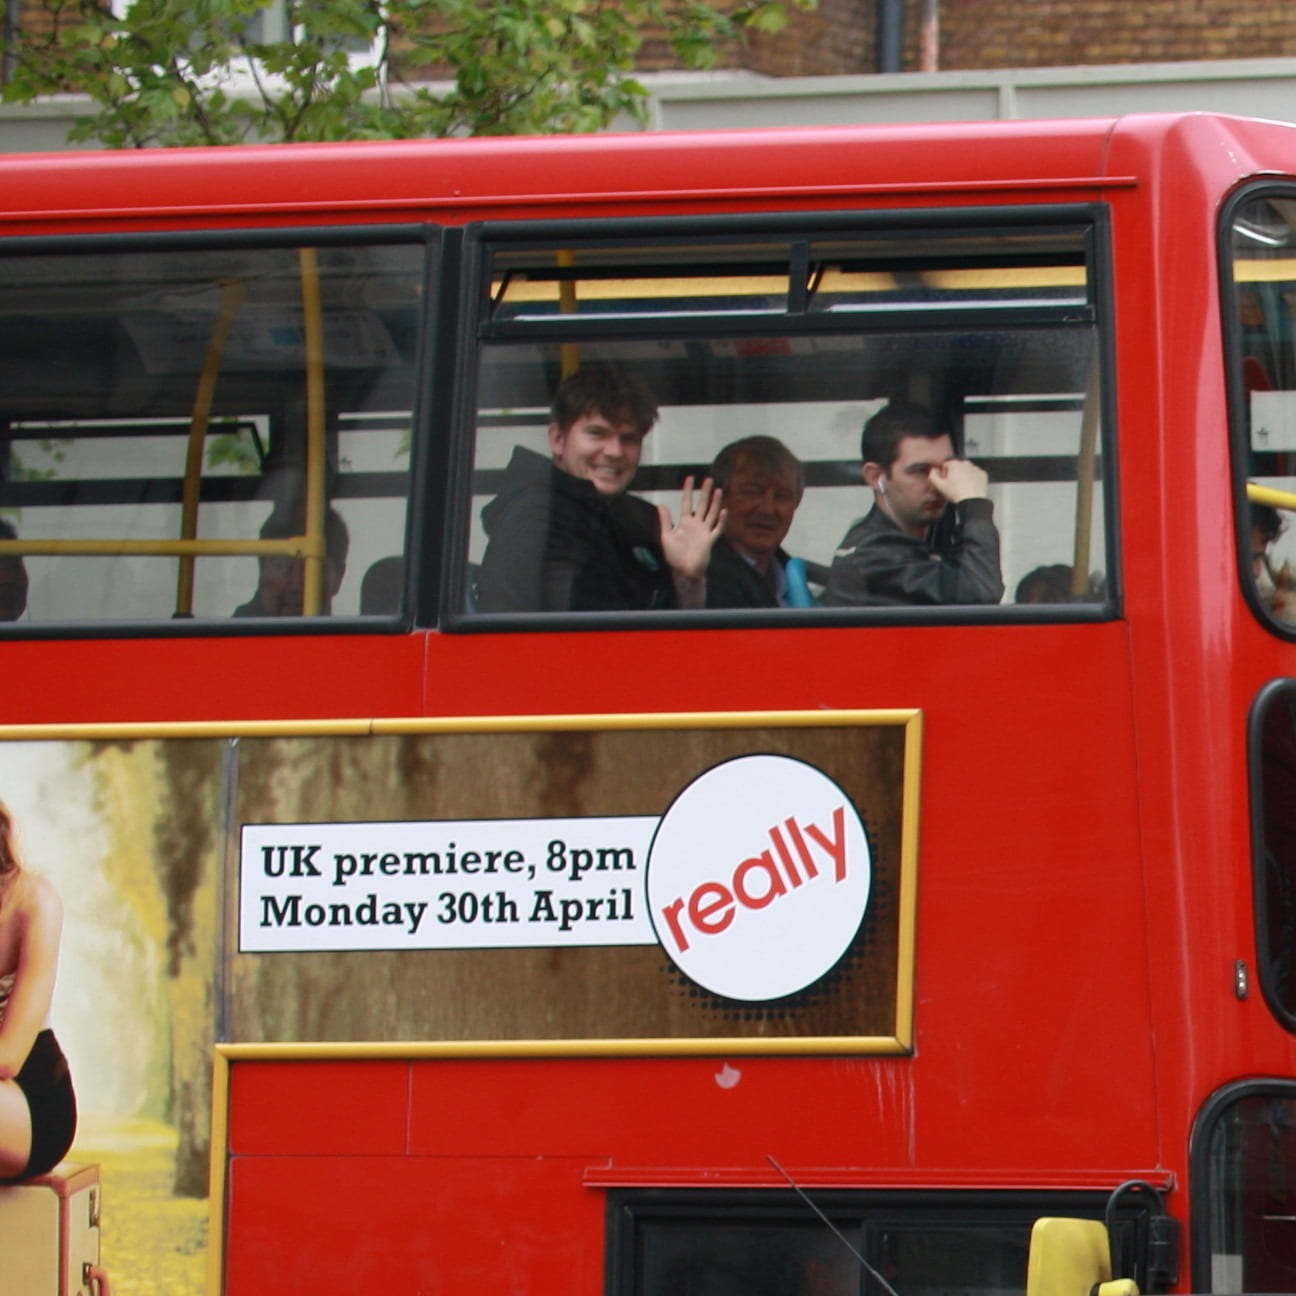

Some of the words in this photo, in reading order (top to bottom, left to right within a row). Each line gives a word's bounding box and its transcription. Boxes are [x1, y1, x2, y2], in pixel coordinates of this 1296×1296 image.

[261, 844, 322, 878] UK
[331, 841, 536, 887] premiere,
[546, 838, 637, 882] 8pm
[661, 805, 847, 954] really
[260, 893, 429, 935] Monday
[437, 890, 520, 925] 30th
[528, 888, 634, 932] April
